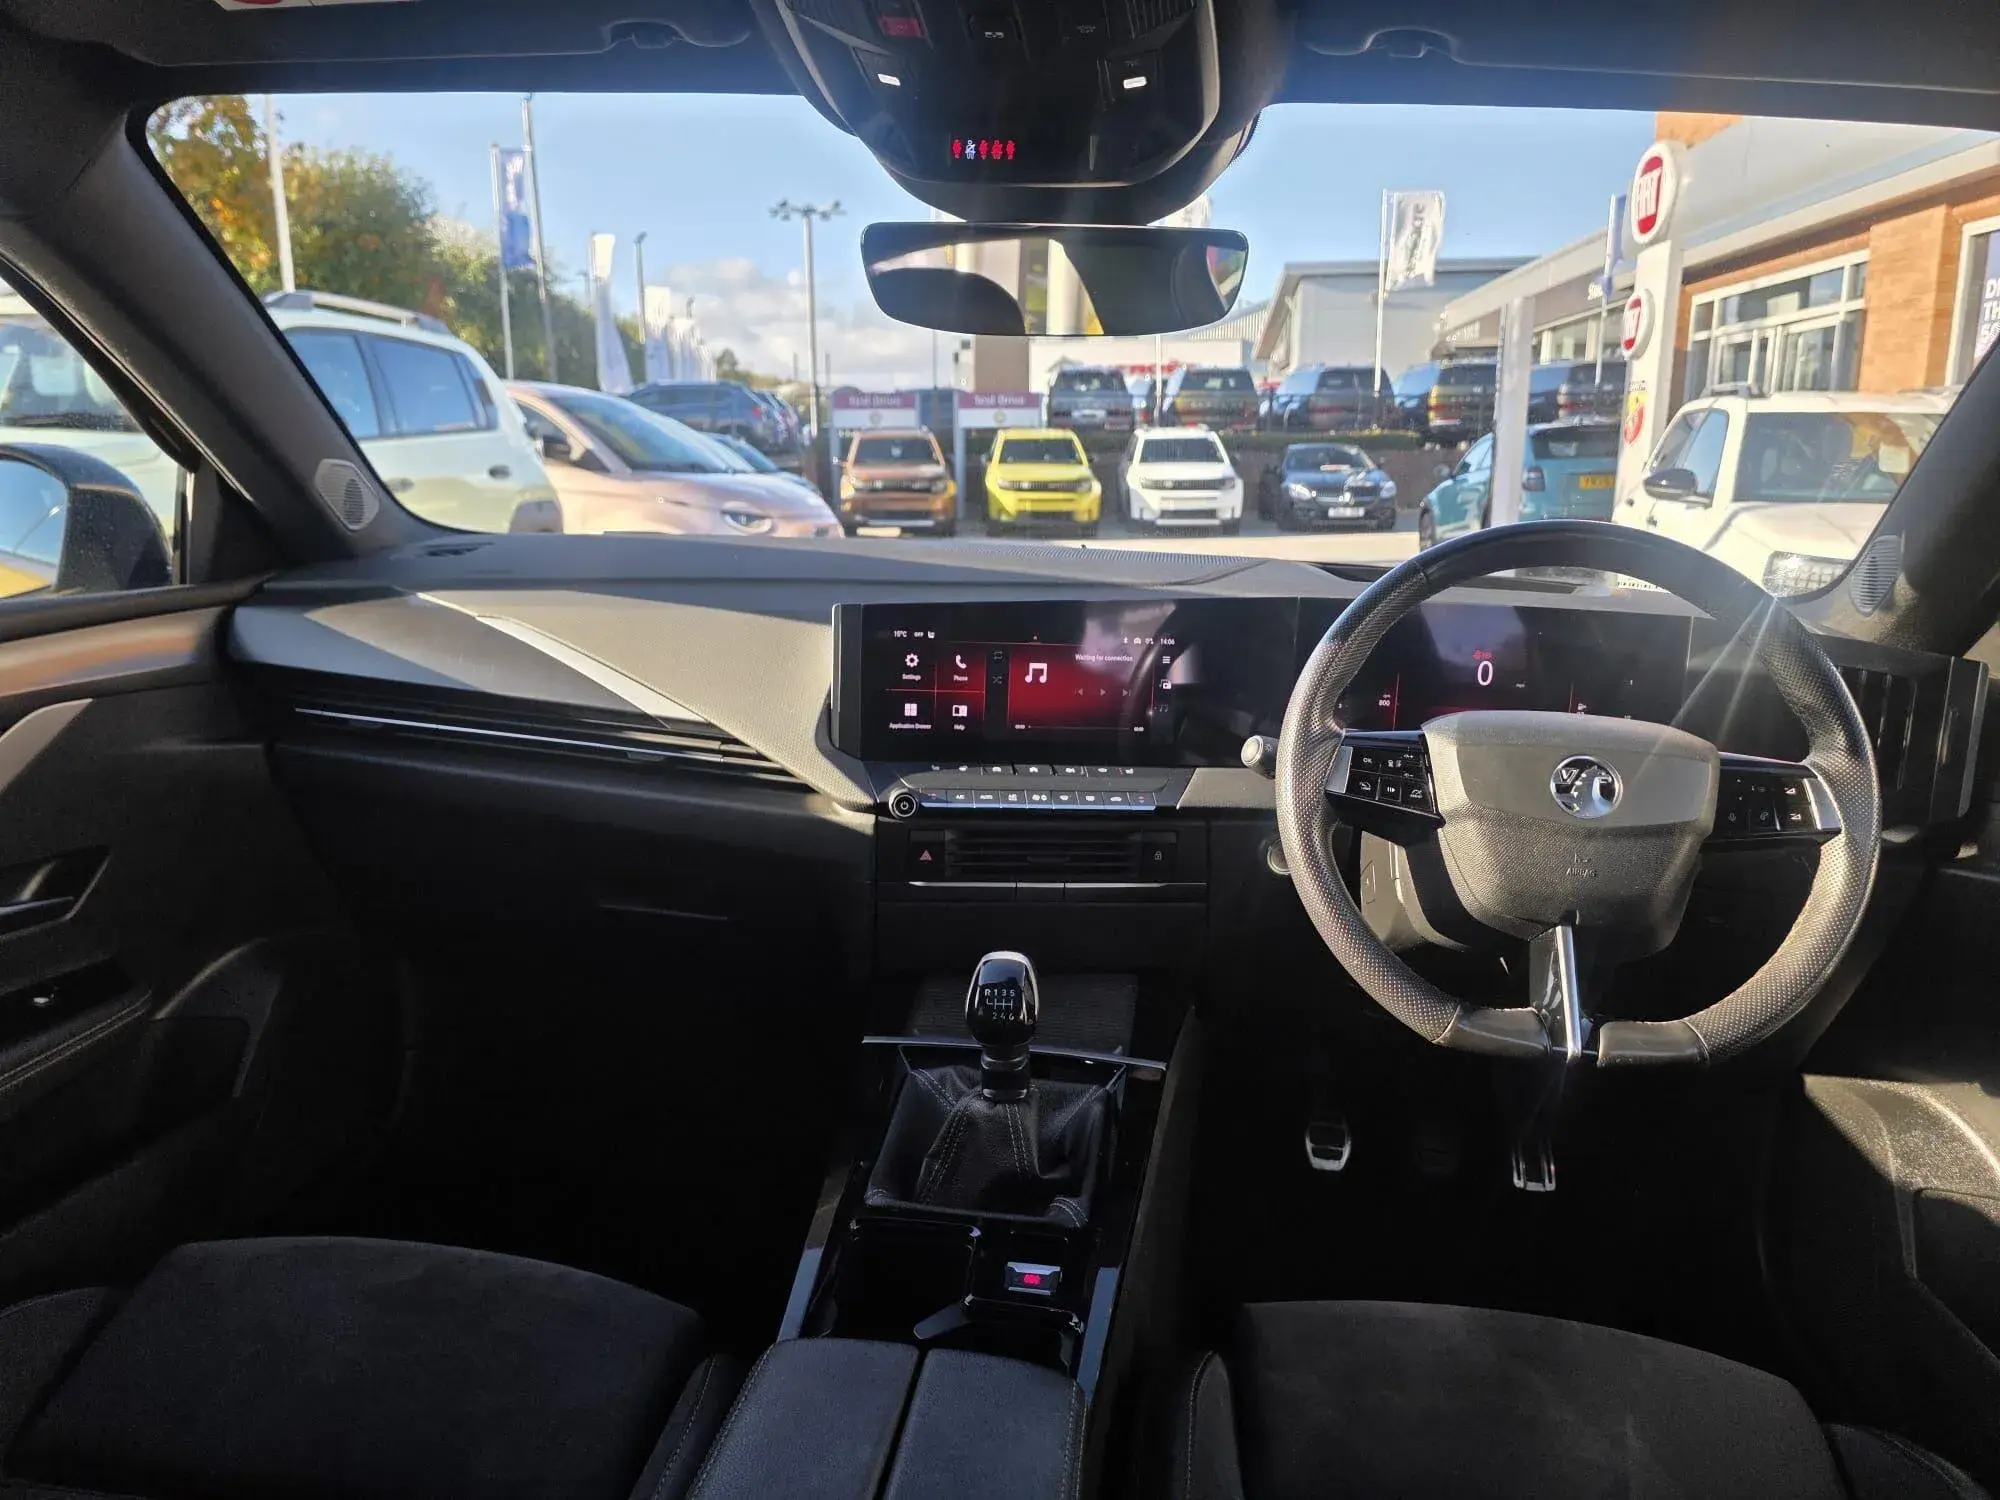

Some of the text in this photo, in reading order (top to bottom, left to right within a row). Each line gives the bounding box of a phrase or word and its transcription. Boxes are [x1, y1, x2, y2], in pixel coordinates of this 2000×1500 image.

[1637, 166, 1663, 221] FIAT
[1160, 637, 1175, 646] 14:06
[1075, 653, 1096, 663] Waiting
[1096, 654, 1104, 662] for
[902, 673, 921, 681] Settings
[1477, 660, 1493, 686] 0
[1566, 867, 1596, 878] AIRBAG
